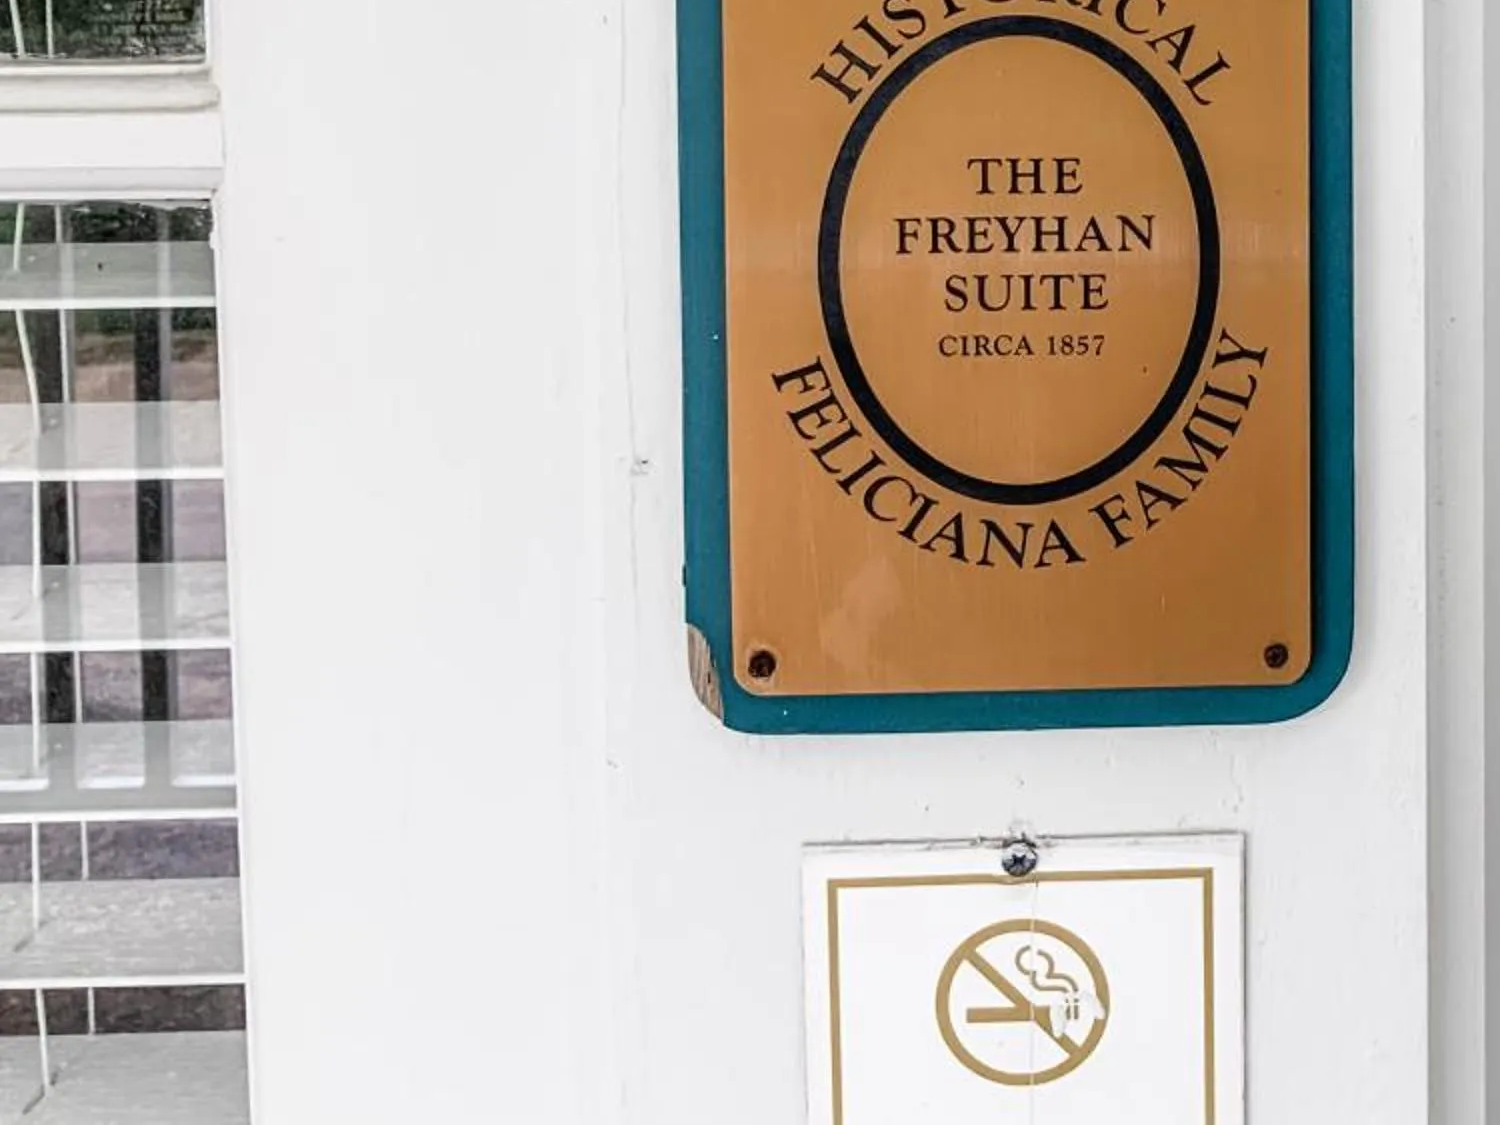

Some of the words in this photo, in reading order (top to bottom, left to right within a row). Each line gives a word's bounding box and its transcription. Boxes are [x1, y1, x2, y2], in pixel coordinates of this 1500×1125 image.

[967, 157, 1083, 195] THE
[895, 214, 1155, 254] FREYHAN
[944, 273, 1109, 312] SUITE
[938, 334, 1036, 357] CIRCA
[1045, 334, 1106, 357] 1857
[771, 356, 1086, 568] FELICIANA
[1088, 328, 1268, 548] FAMILY
